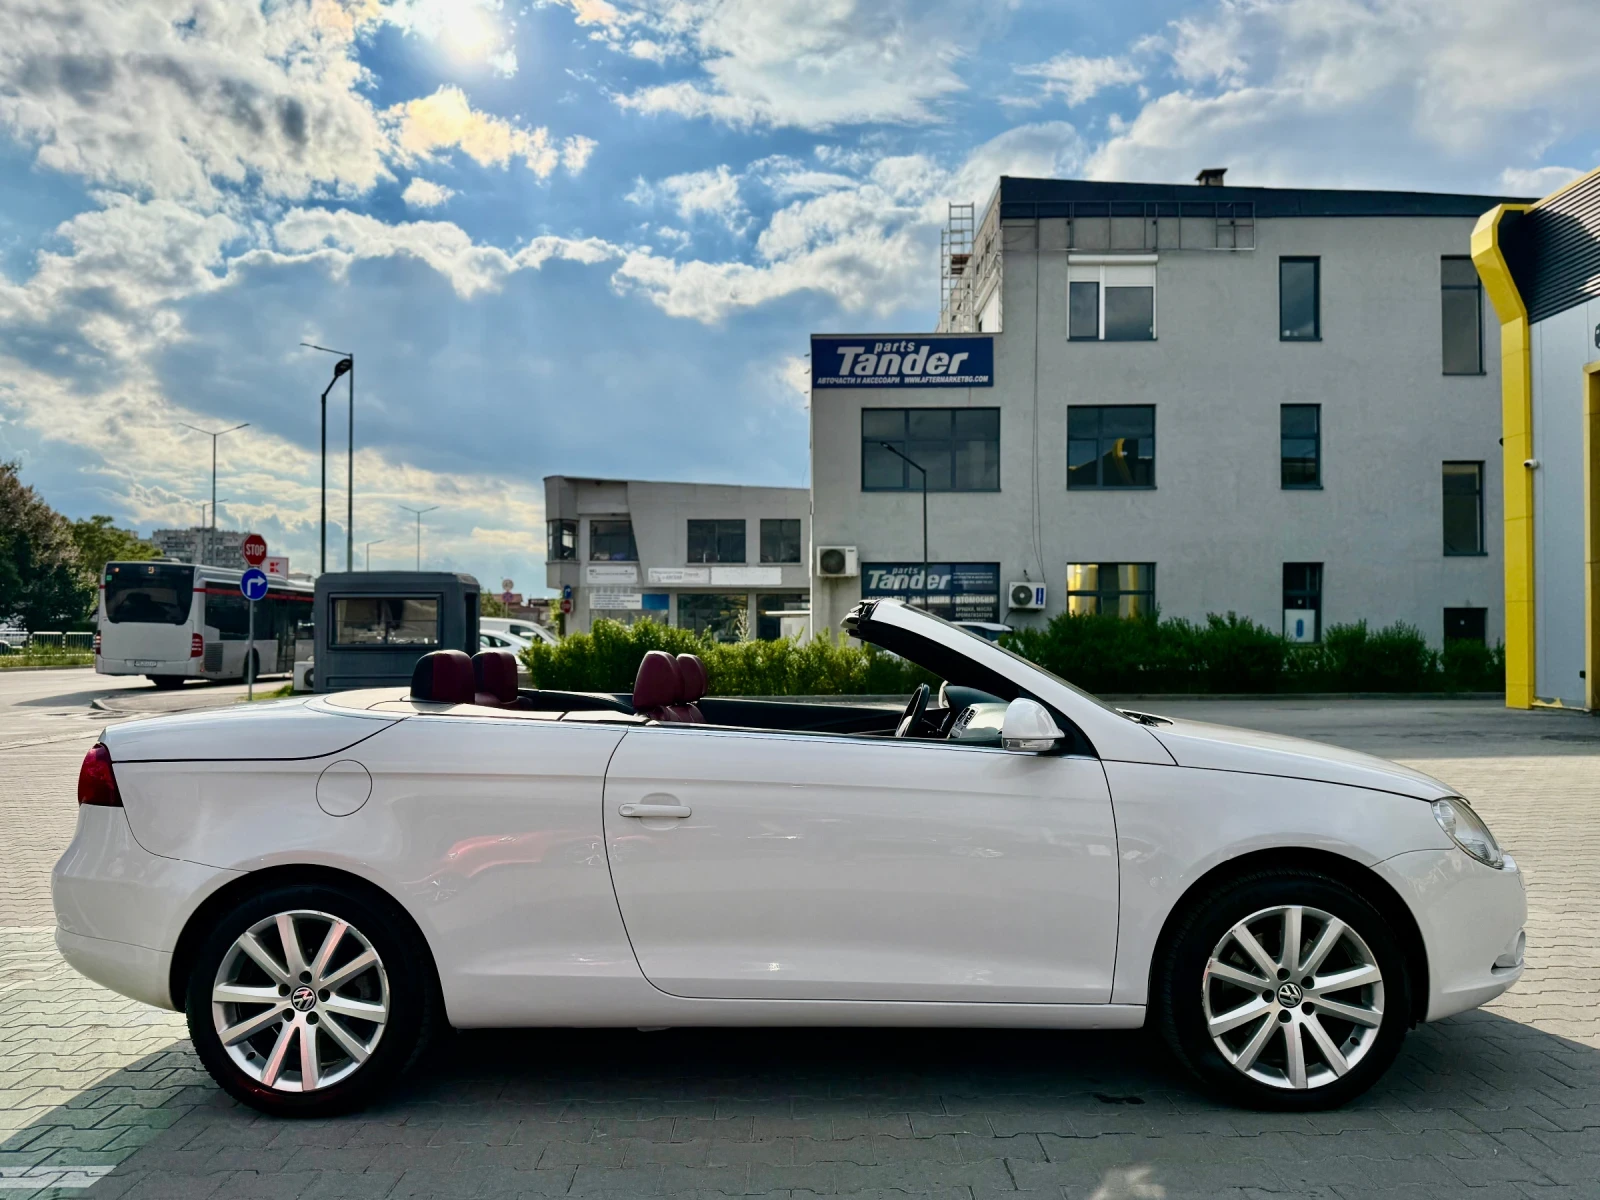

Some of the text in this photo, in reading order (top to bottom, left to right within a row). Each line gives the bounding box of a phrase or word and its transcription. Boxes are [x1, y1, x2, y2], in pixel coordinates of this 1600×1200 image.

[873, 341, 916, 354] parts
[836, 346, 969, 376] Tander
[817, 377, 855, 385] АВТОЧАСТИ
[862, 376, 900, 384] АКСЕСОАРИ
[245, 543, 265, 556] STOP
[892, 567, 919, 575] parts
[867, 569, 952, 590] Tander
